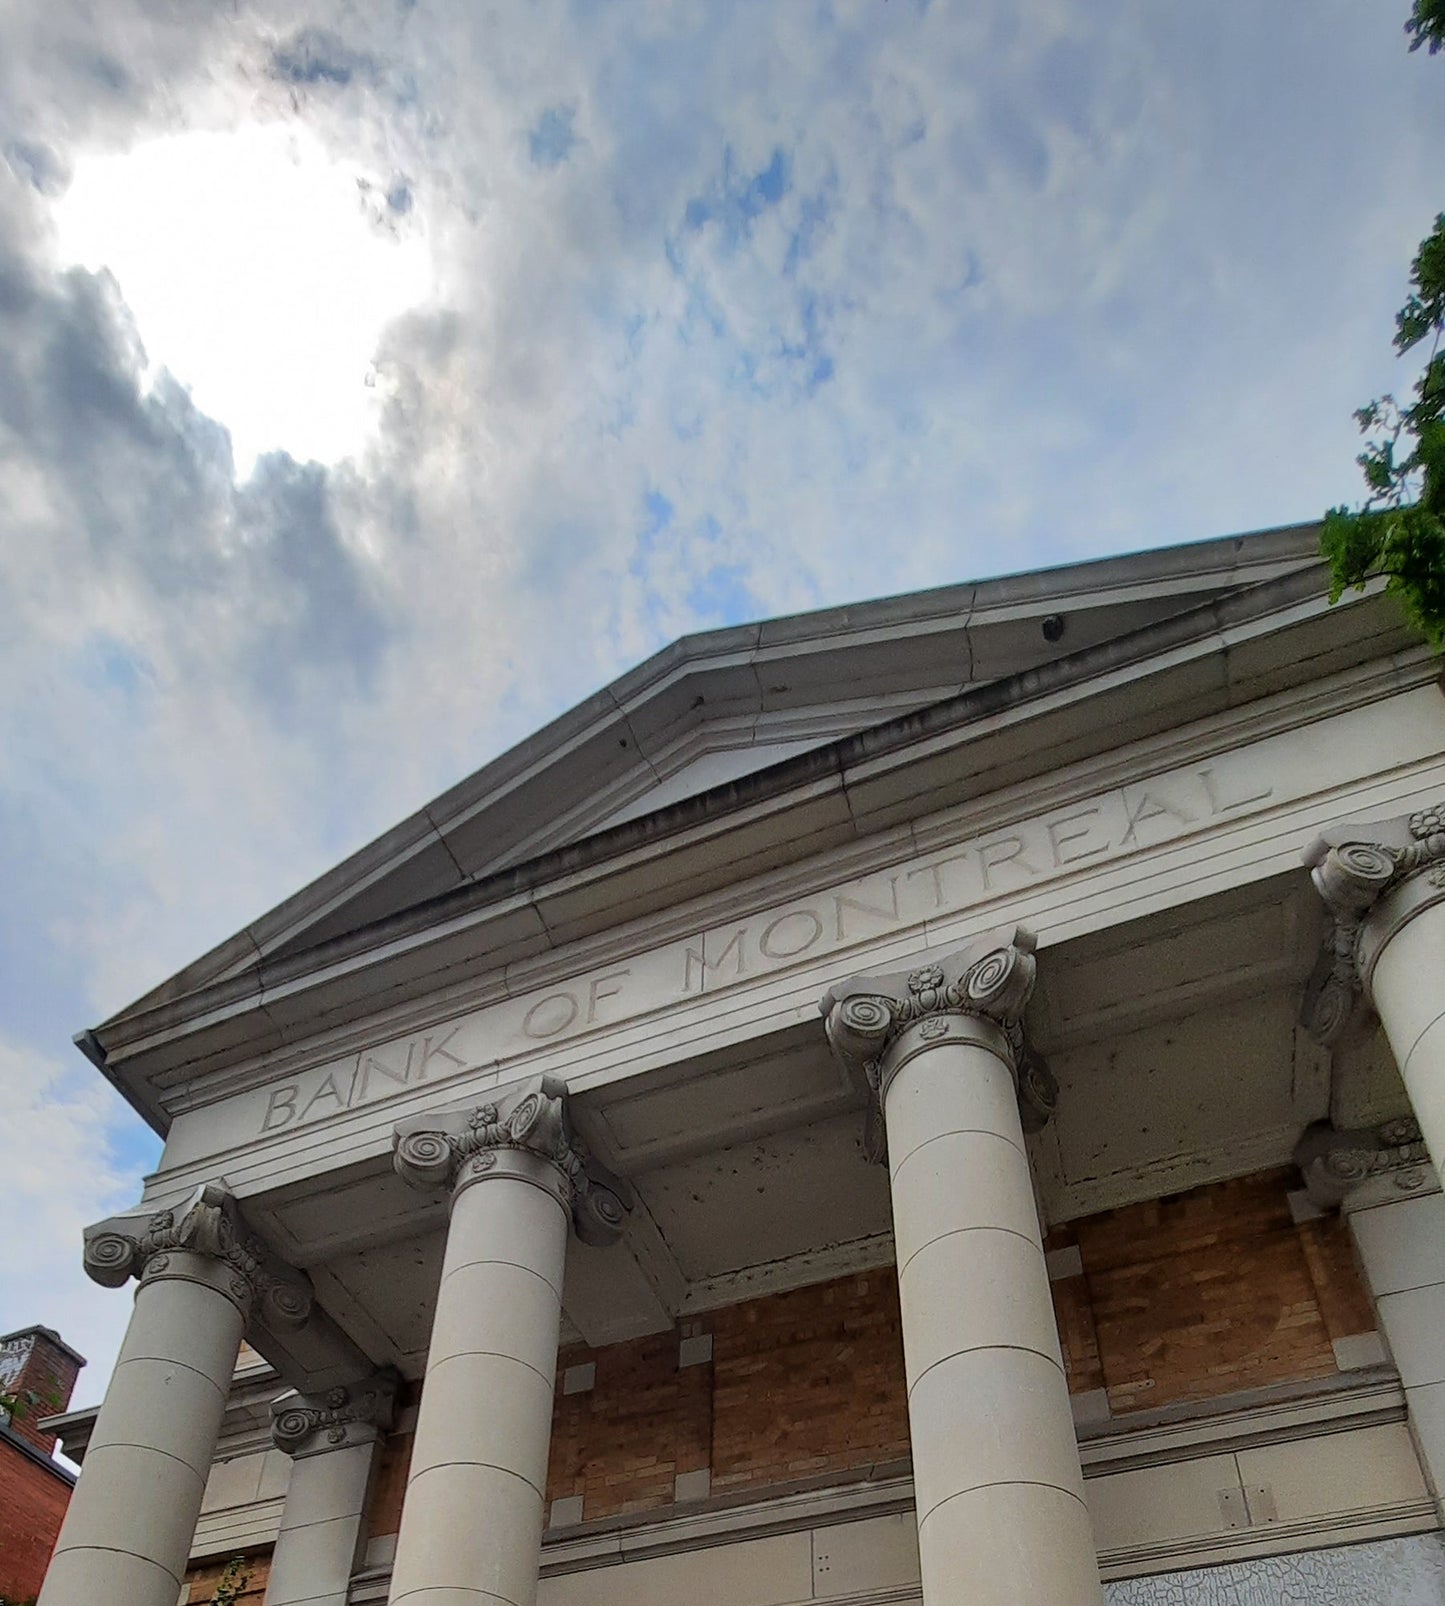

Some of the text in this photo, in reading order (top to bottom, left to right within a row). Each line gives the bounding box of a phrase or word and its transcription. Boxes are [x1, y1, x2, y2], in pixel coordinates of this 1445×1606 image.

[260, 768, 1274, 1133] BANK OF MONTREAL
